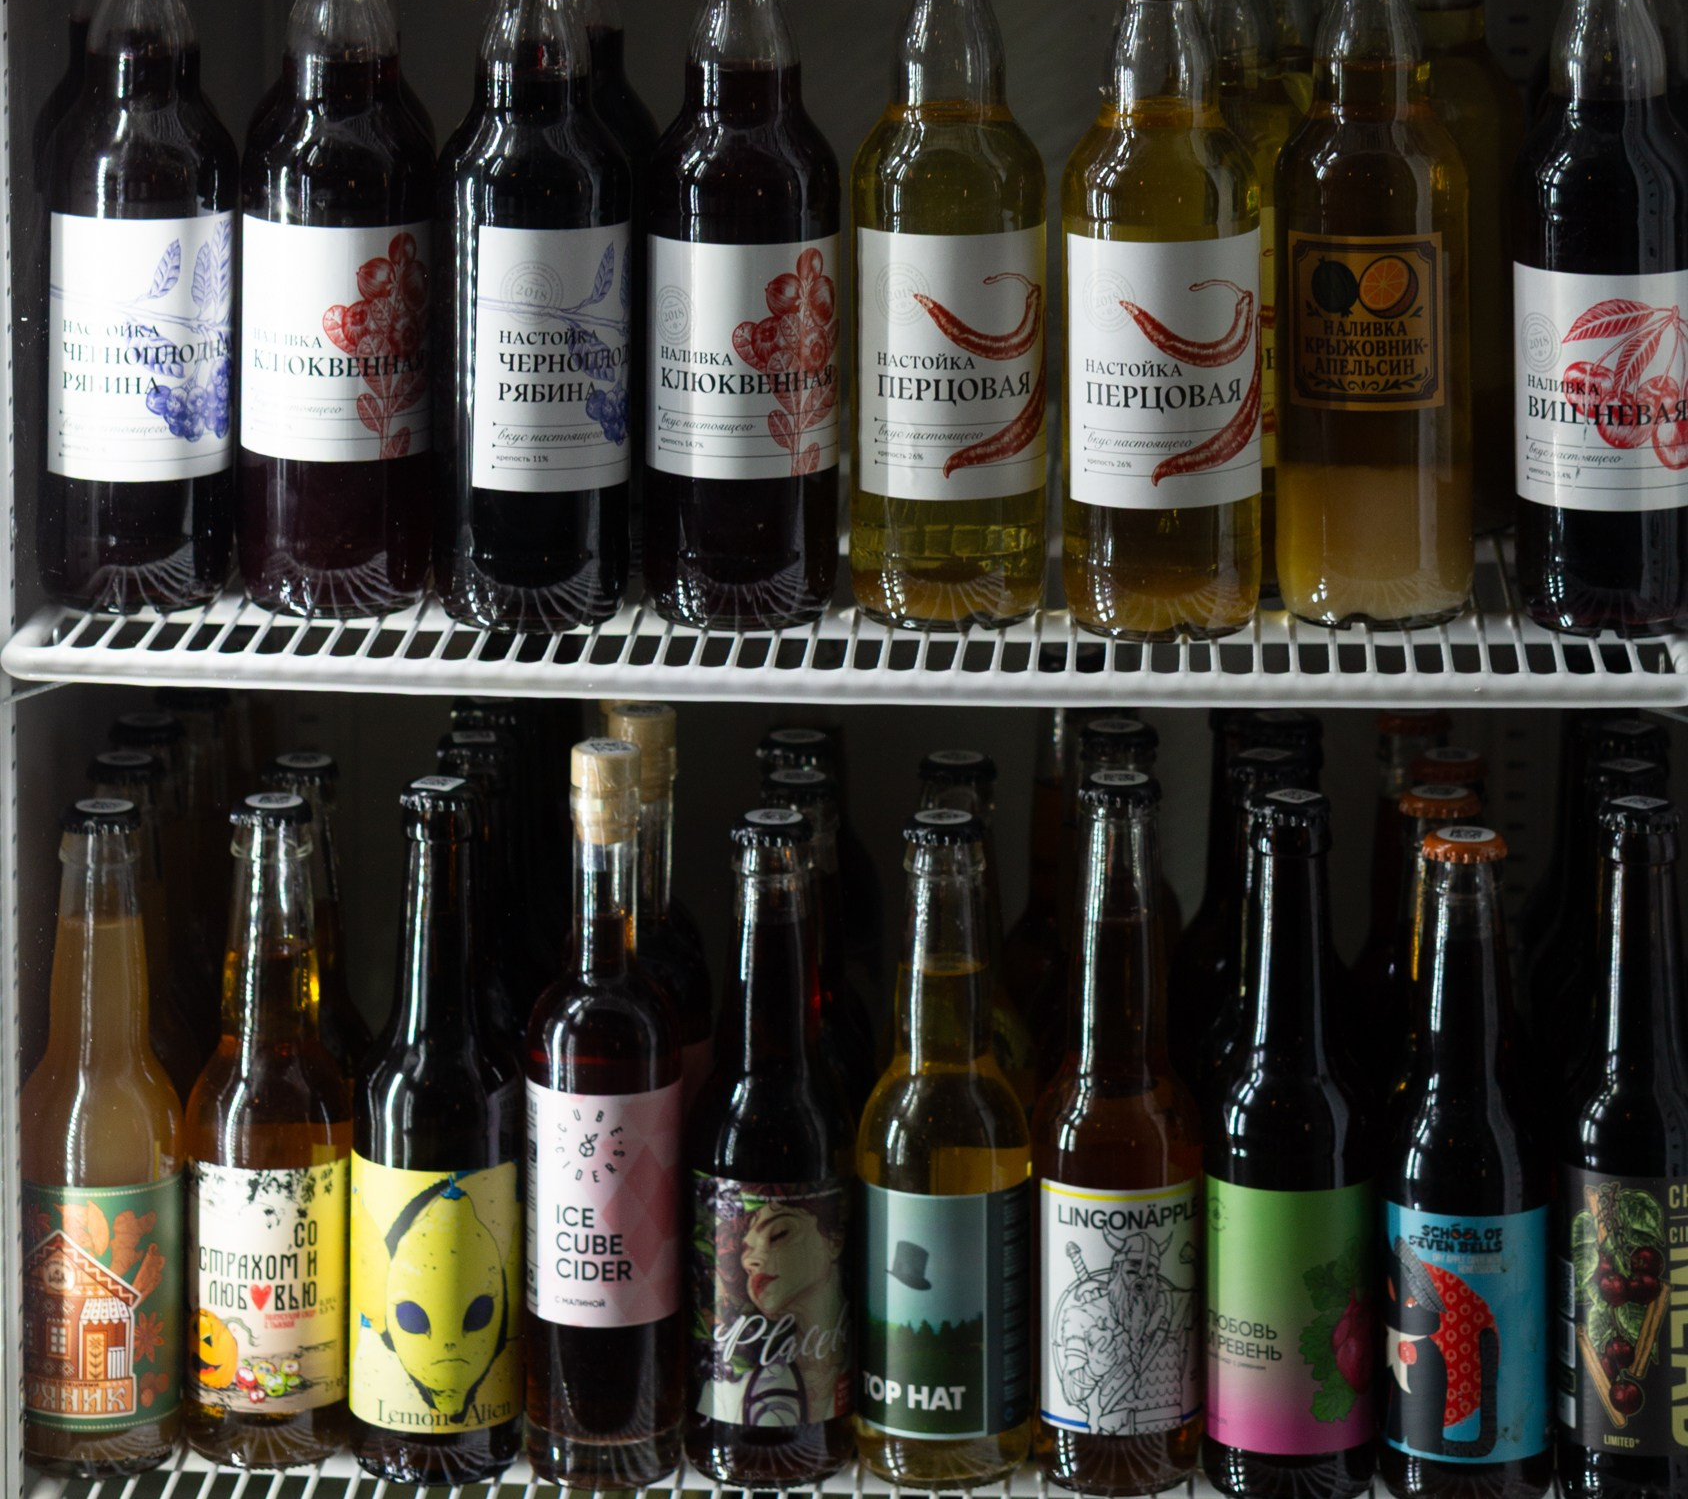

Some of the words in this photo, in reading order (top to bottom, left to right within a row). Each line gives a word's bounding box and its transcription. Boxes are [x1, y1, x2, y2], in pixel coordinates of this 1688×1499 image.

[515, 284, 548, 301] 2018
[662, 308, 685, 322] 2018
[63, 319, 160, 337] НАСОЙКА
[499, 328, 598, 346] НАСТОЙКА
[1324, 321, 1407, 337] НАЛИВКА
[1305, 337, 1428, 356] КРЫЖОВНИК-
[1529, 336, 1550, 350] 2018
[660, 345, 733, 366] НАЛИВКА
[877, 352, 975, 370] НАСТОЙКА
[1085, 359, 1183, 377] НАСТОЙКА
[1315, 358, 1415, 376] АПЕЛЬСИН
[63, 372, 161, 394] РЯИНА
[661, 363, 834, 395] КЛЮКВЕННАЯ
[878, 372, 1031, 406] ПЕРЦОВАЯ
[1527, 374, 1600, 396] НАЛИВКА
[498, 381, 597, 403] РЯБИНА
[1086, 379, 1242, 414] ПЕРЦОВАЯ
[1528, 395, 1688, 426] ВИШНЕВАЯ
[661, 412, 682, 428] вкус
[683, 419, 756, 434] настоящего
[878, 425, 903, 440] вкус
[905, 431, 984, 441] настоящего
[498, 427, 528, 445] вкус
[530, 430, 604, 446] настоящего
[1088, 432, 1112, 448] вкус
[1114, 438, 1192, 451] настоящего
[556, 1204, 595, 1228] ICE
[1058, 1196, 1199, 1231] LINGONÄPPLE
[294, 1220, 318, 1248] СО
[556, 1232, 623, 1255] CUBE
[1409, 1235, 1454, 1252] SEVEN
[1458, 1241, 1502, 1253] BELLS
[1484, 1228, 1503, 1240] OF
[556, 1258, 633, 1282] CIDER
[562, 1297, 606, 1308] МАЛИНОЙ
[1218, 1335, 1282, 1361] РЕВЕНЬ
[862, 1370, 902, 1405] TOP
[907, 1384, 966, 1411] HAT
[377, 1399, 450, 1427] Lemon
[463, 1401, 512, 1427] Alien
